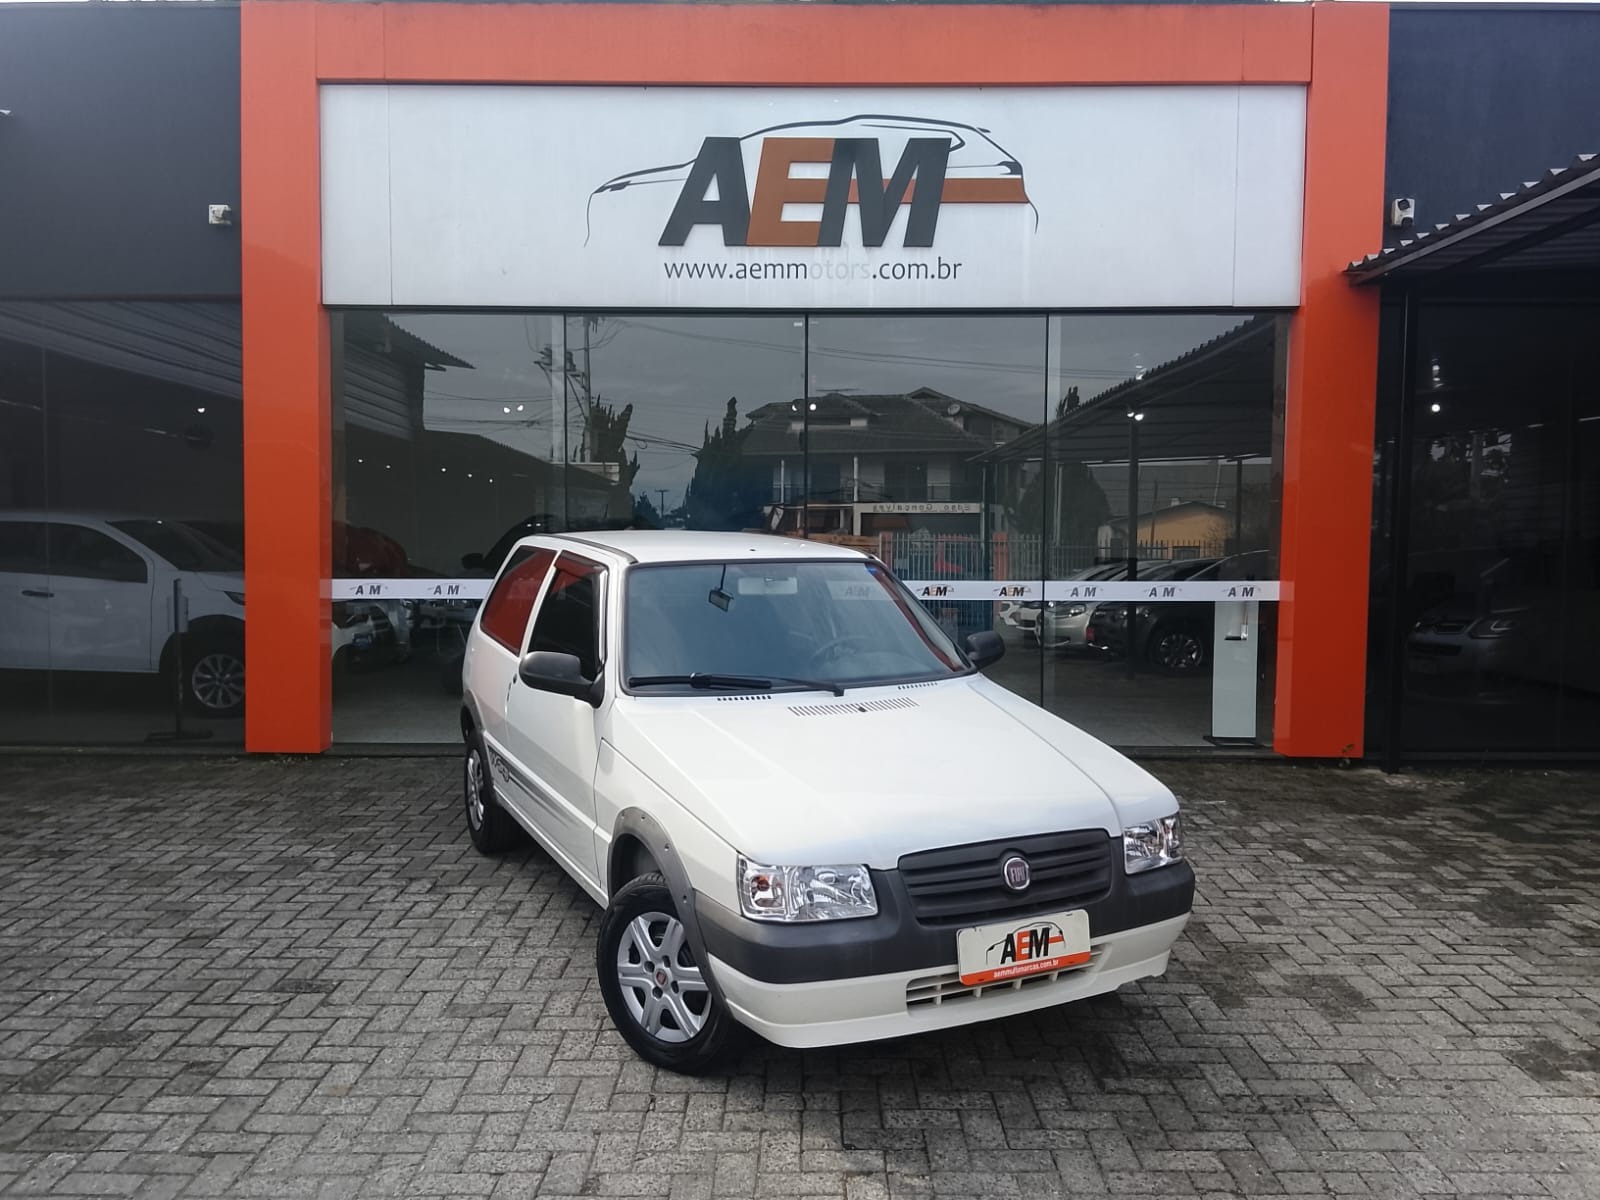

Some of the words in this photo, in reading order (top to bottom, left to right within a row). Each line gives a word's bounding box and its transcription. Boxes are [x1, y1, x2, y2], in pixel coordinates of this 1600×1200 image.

[657, 136, 952, 248] AEM
[664, 257, 963, 280] www.aemmotors.com.br
[1000, 927, 1050, 965] AEM
